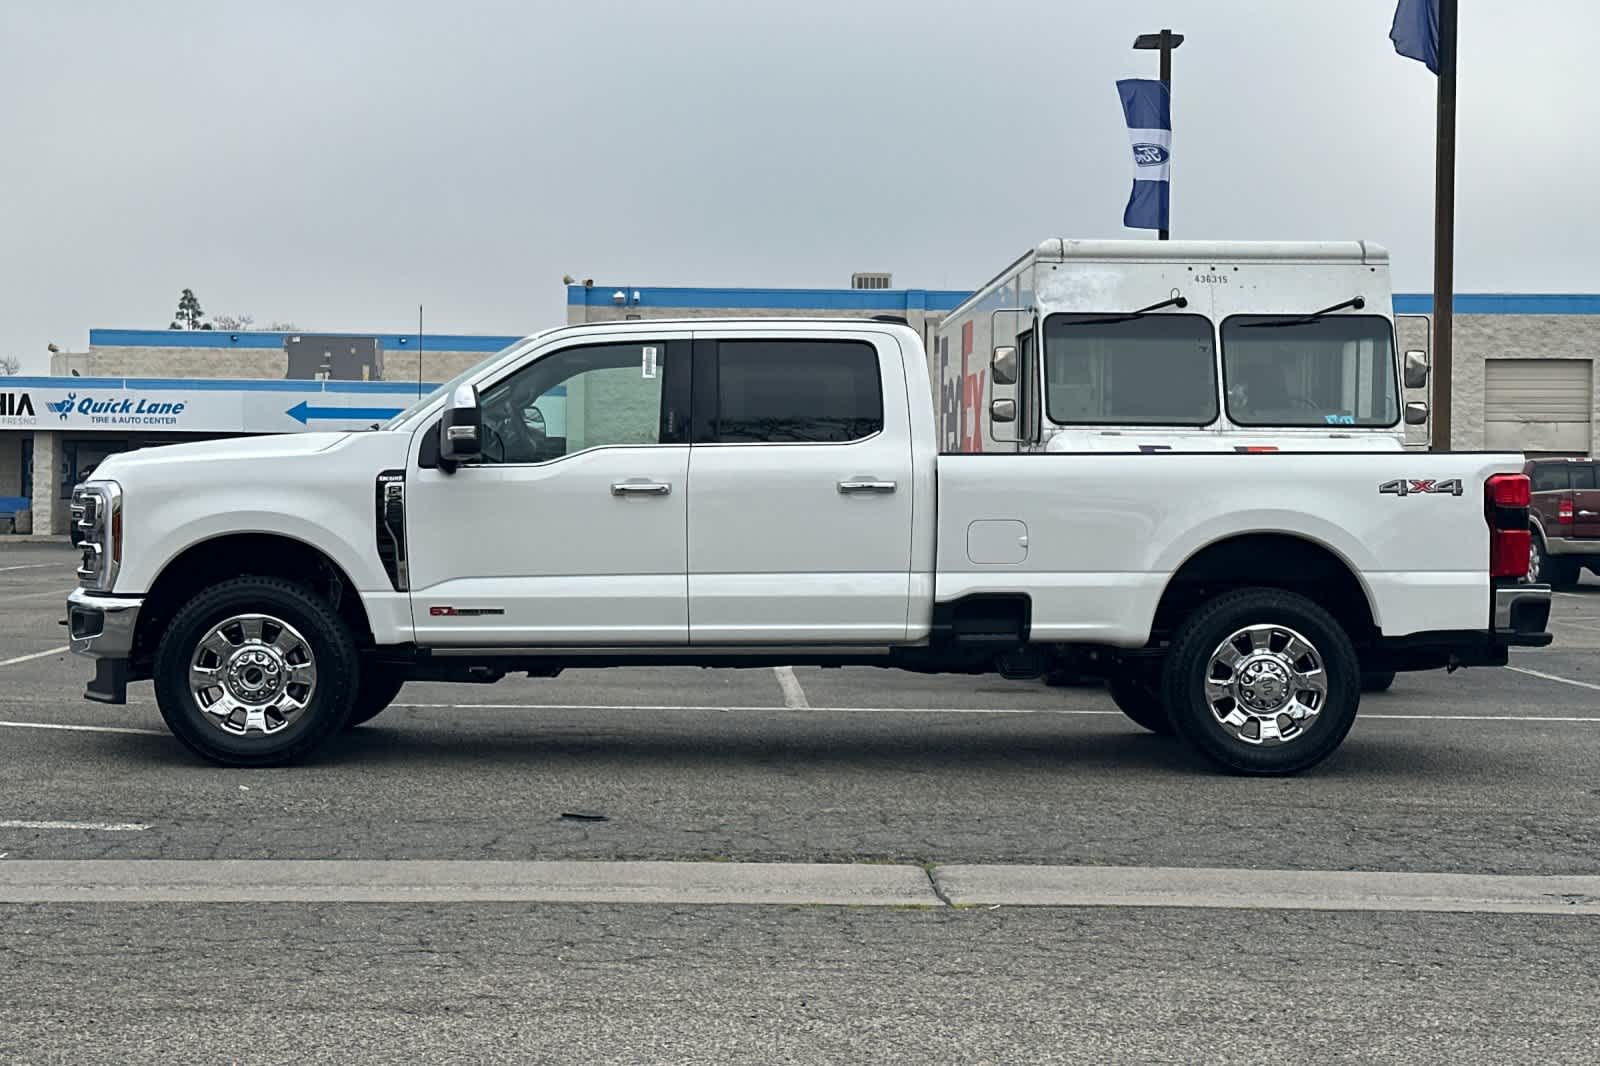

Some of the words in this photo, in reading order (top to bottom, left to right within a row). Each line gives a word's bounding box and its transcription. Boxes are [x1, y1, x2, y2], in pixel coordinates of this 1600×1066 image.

[1194, 274, 1228, 284] 436315
[77, 397, 134, 415] Quick
[135, 399, 185, 415] Lane
[2, 417, 37, 425] FRESNO
[91, 416, 109, 424] TIRE
[111, 416, 117, 424] &
[119, 416, 142, 424] AUTO
[143, 417, 177, 425] CENTER
